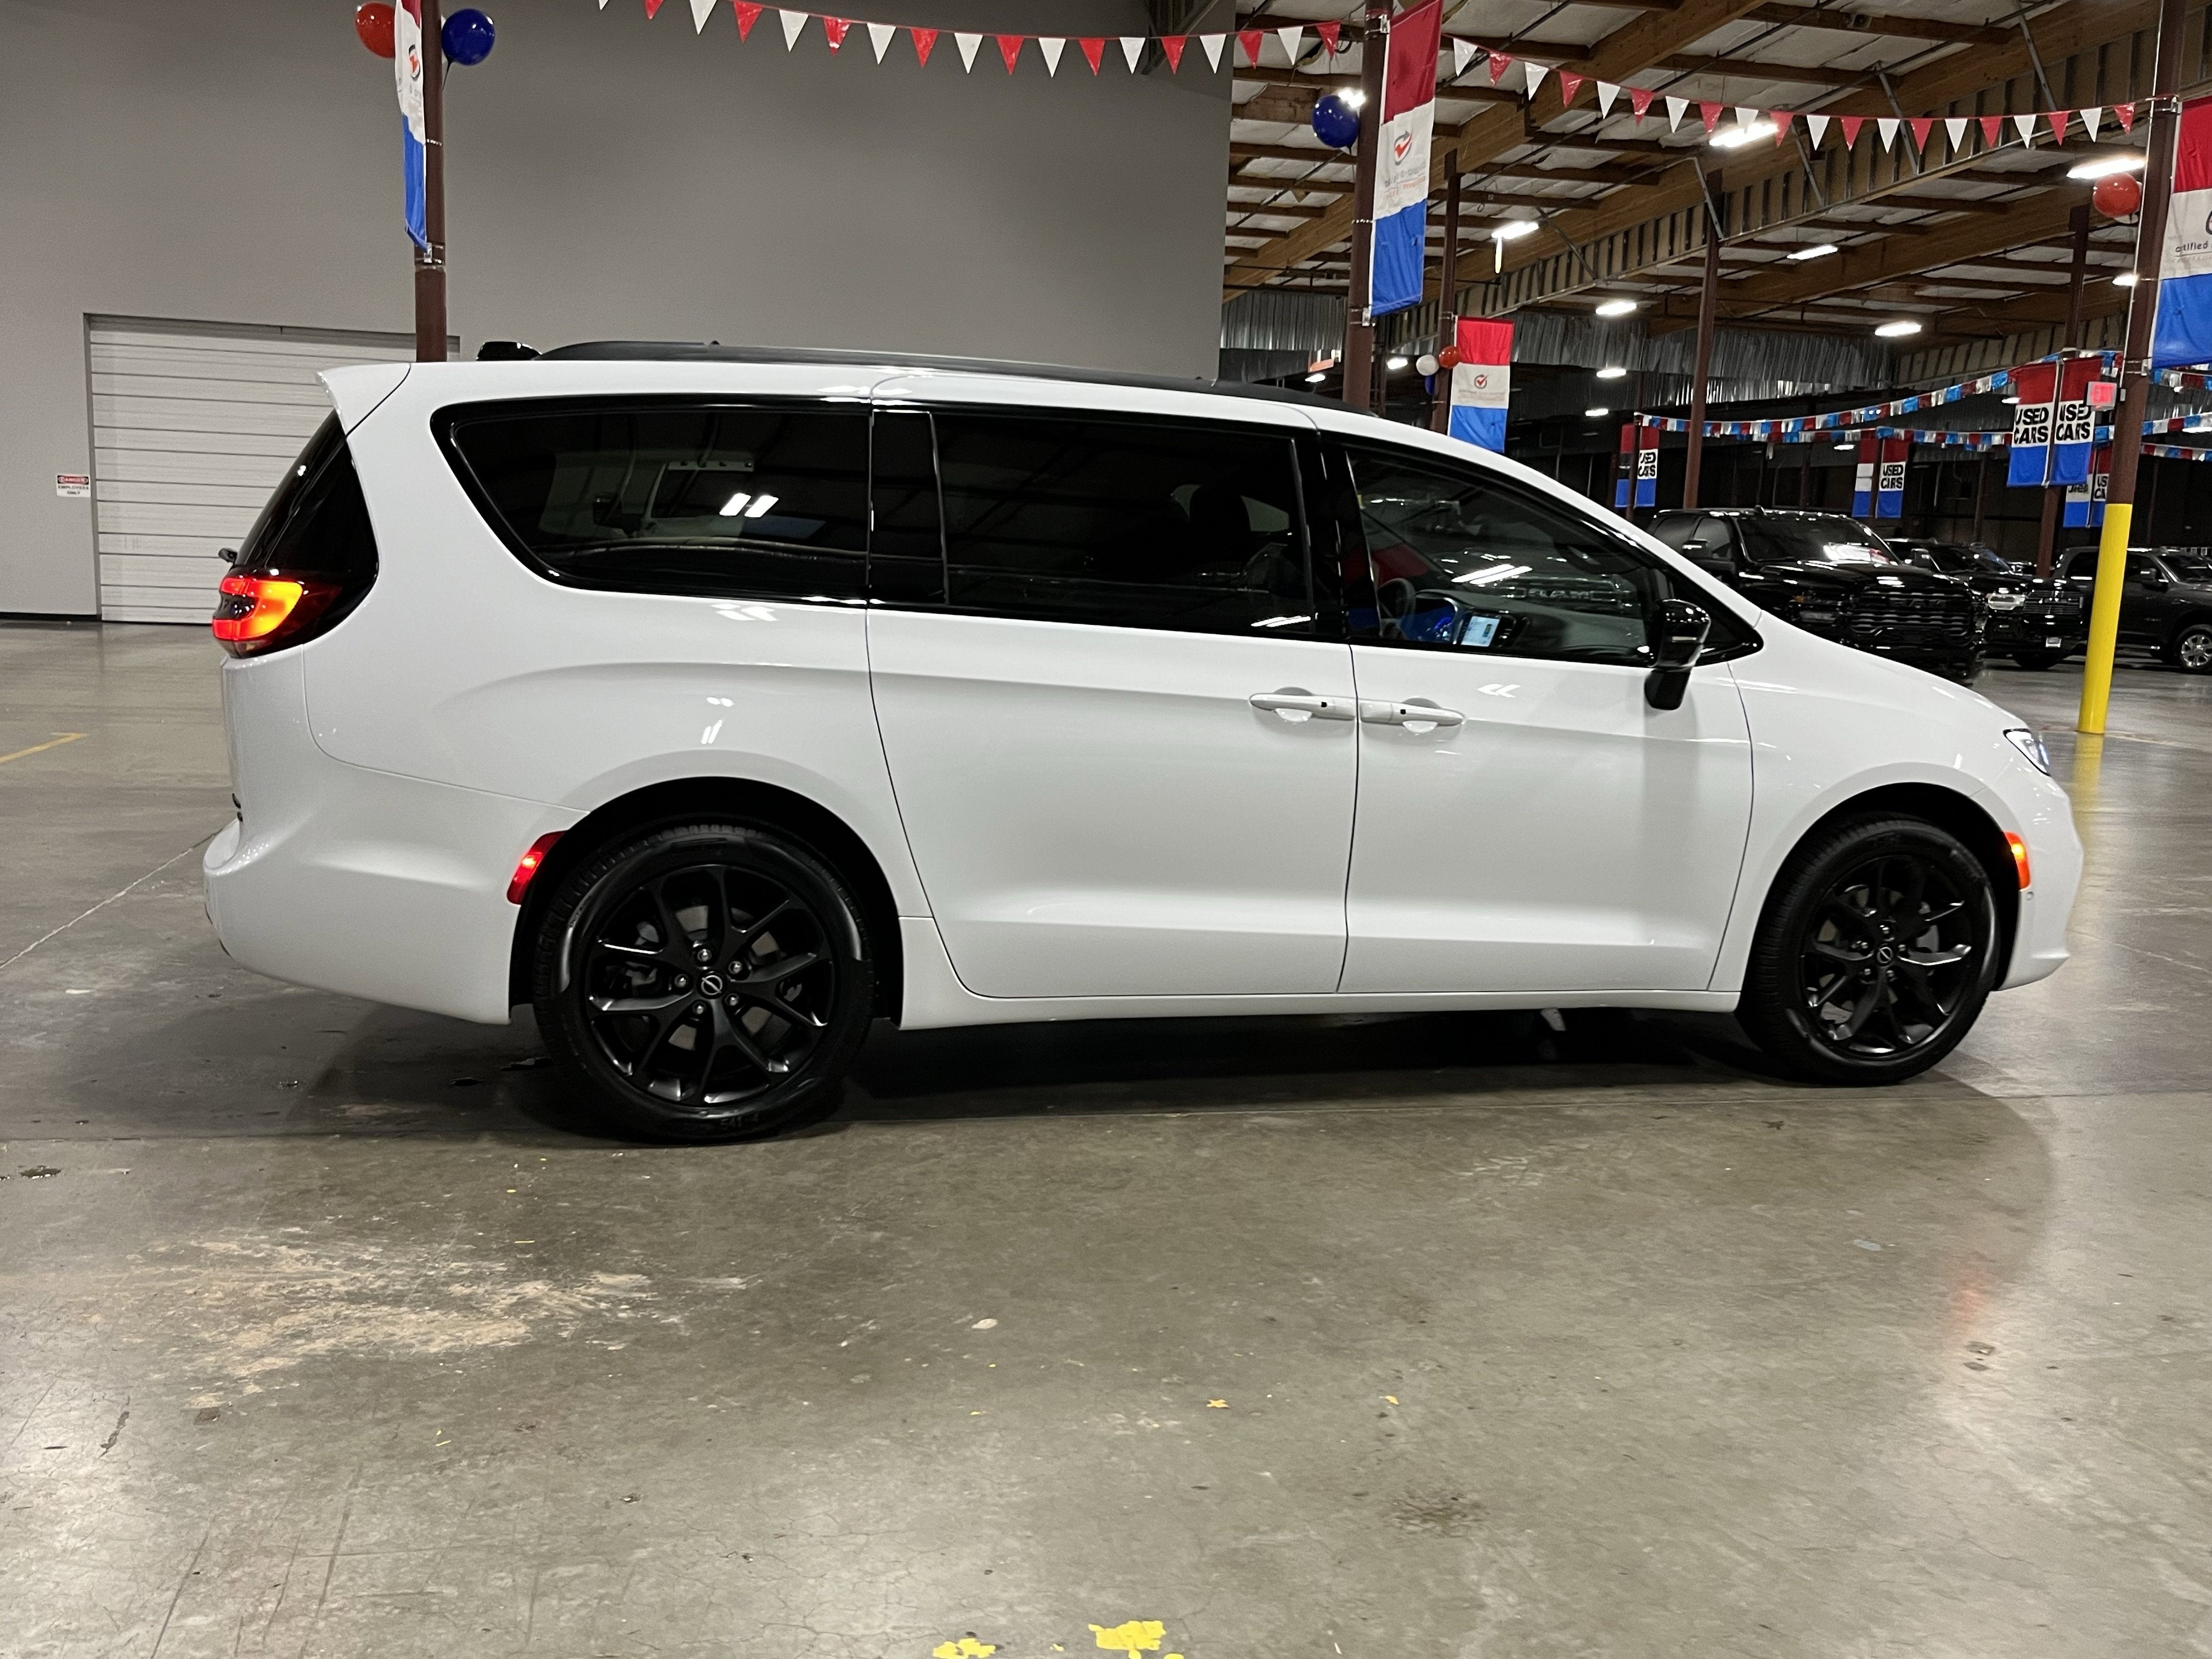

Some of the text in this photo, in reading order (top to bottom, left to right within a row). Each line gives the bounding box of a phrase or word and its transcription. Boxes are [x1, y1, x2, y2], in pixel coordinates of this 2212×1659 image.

[2175, 241, 2208, 252] ctified
[2016, 407, 2049, 425] USED
[2059, 404, 2092, 421] USED
[2014, 426, 2049, 444] CARS
[2056, 421, 2090, 441] CARS
[1640, 452, 1656, 464] UED
[1883, 464, 1904, 476] USED
[2097, 476, 2108, 487] US
[2095, 488, 2106, 499] CA
